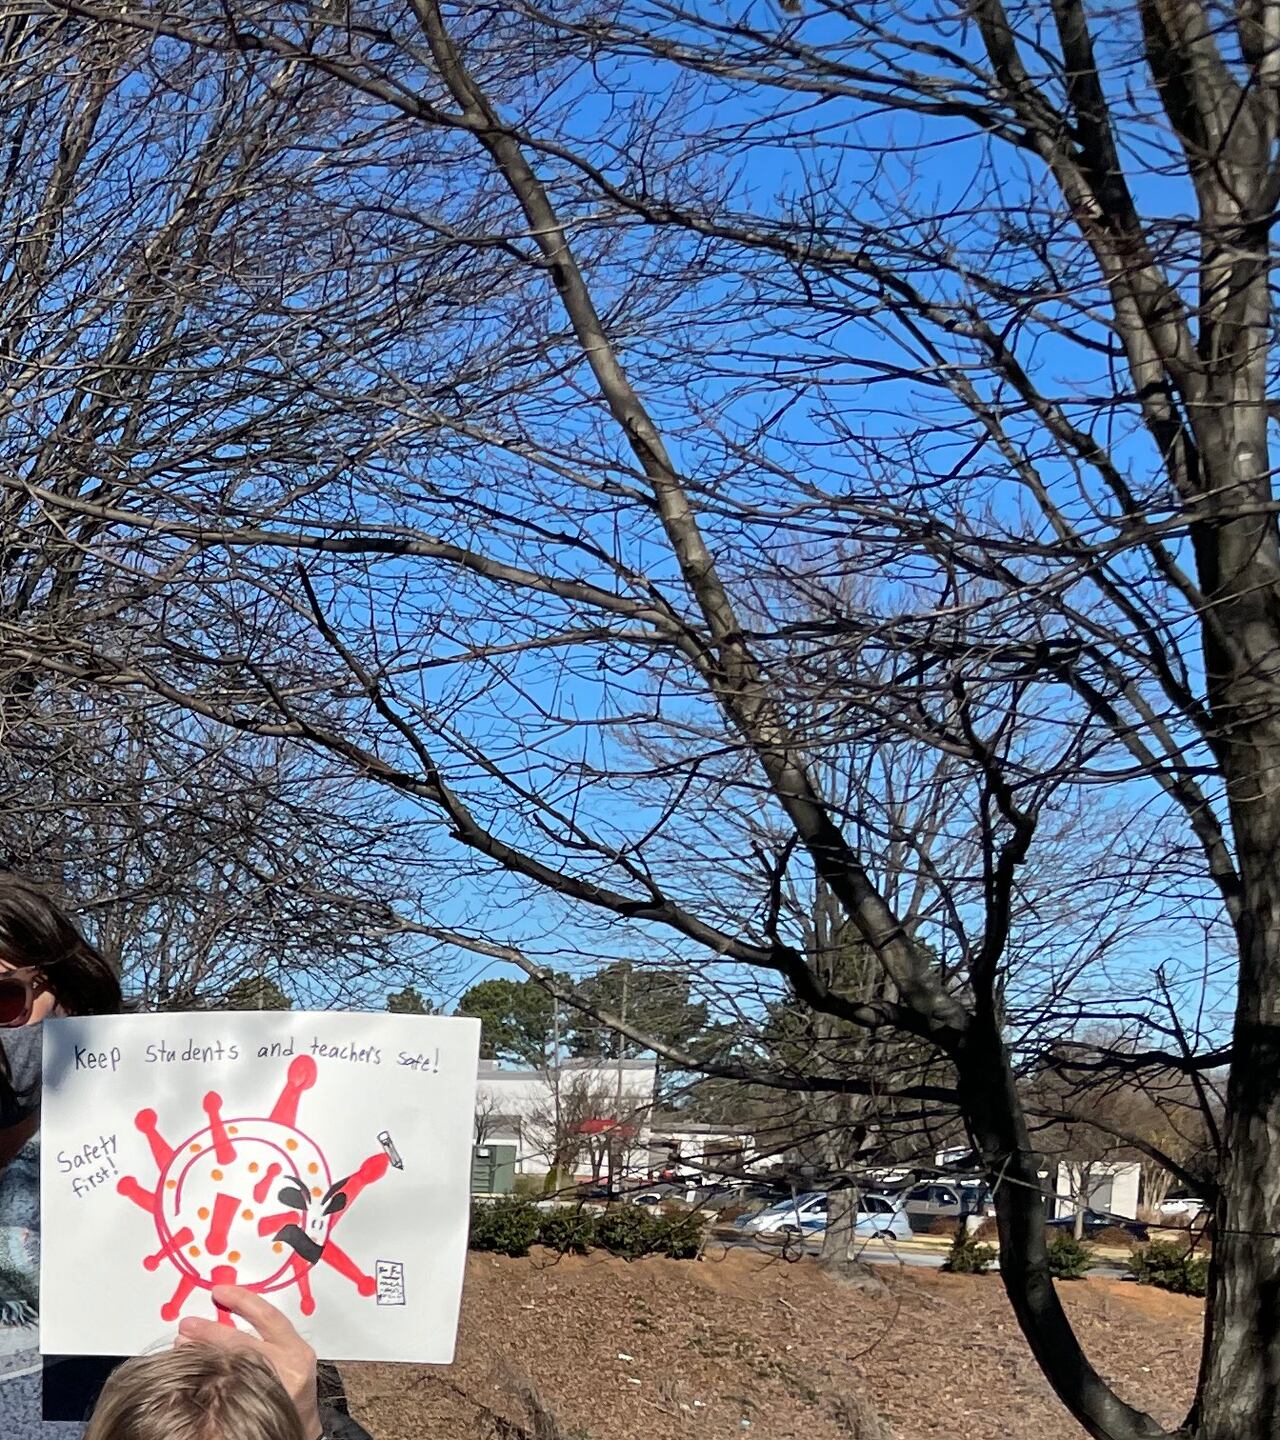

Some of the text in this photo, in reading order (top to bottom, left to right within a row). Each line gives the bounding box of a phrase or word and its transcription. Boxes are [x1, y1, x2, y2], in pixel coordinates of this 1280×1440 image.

[75, 1044, 120, 1071] Keep
[257, 1036, 294, 1058] and
[310, 1036, 381, 1065] teachers
